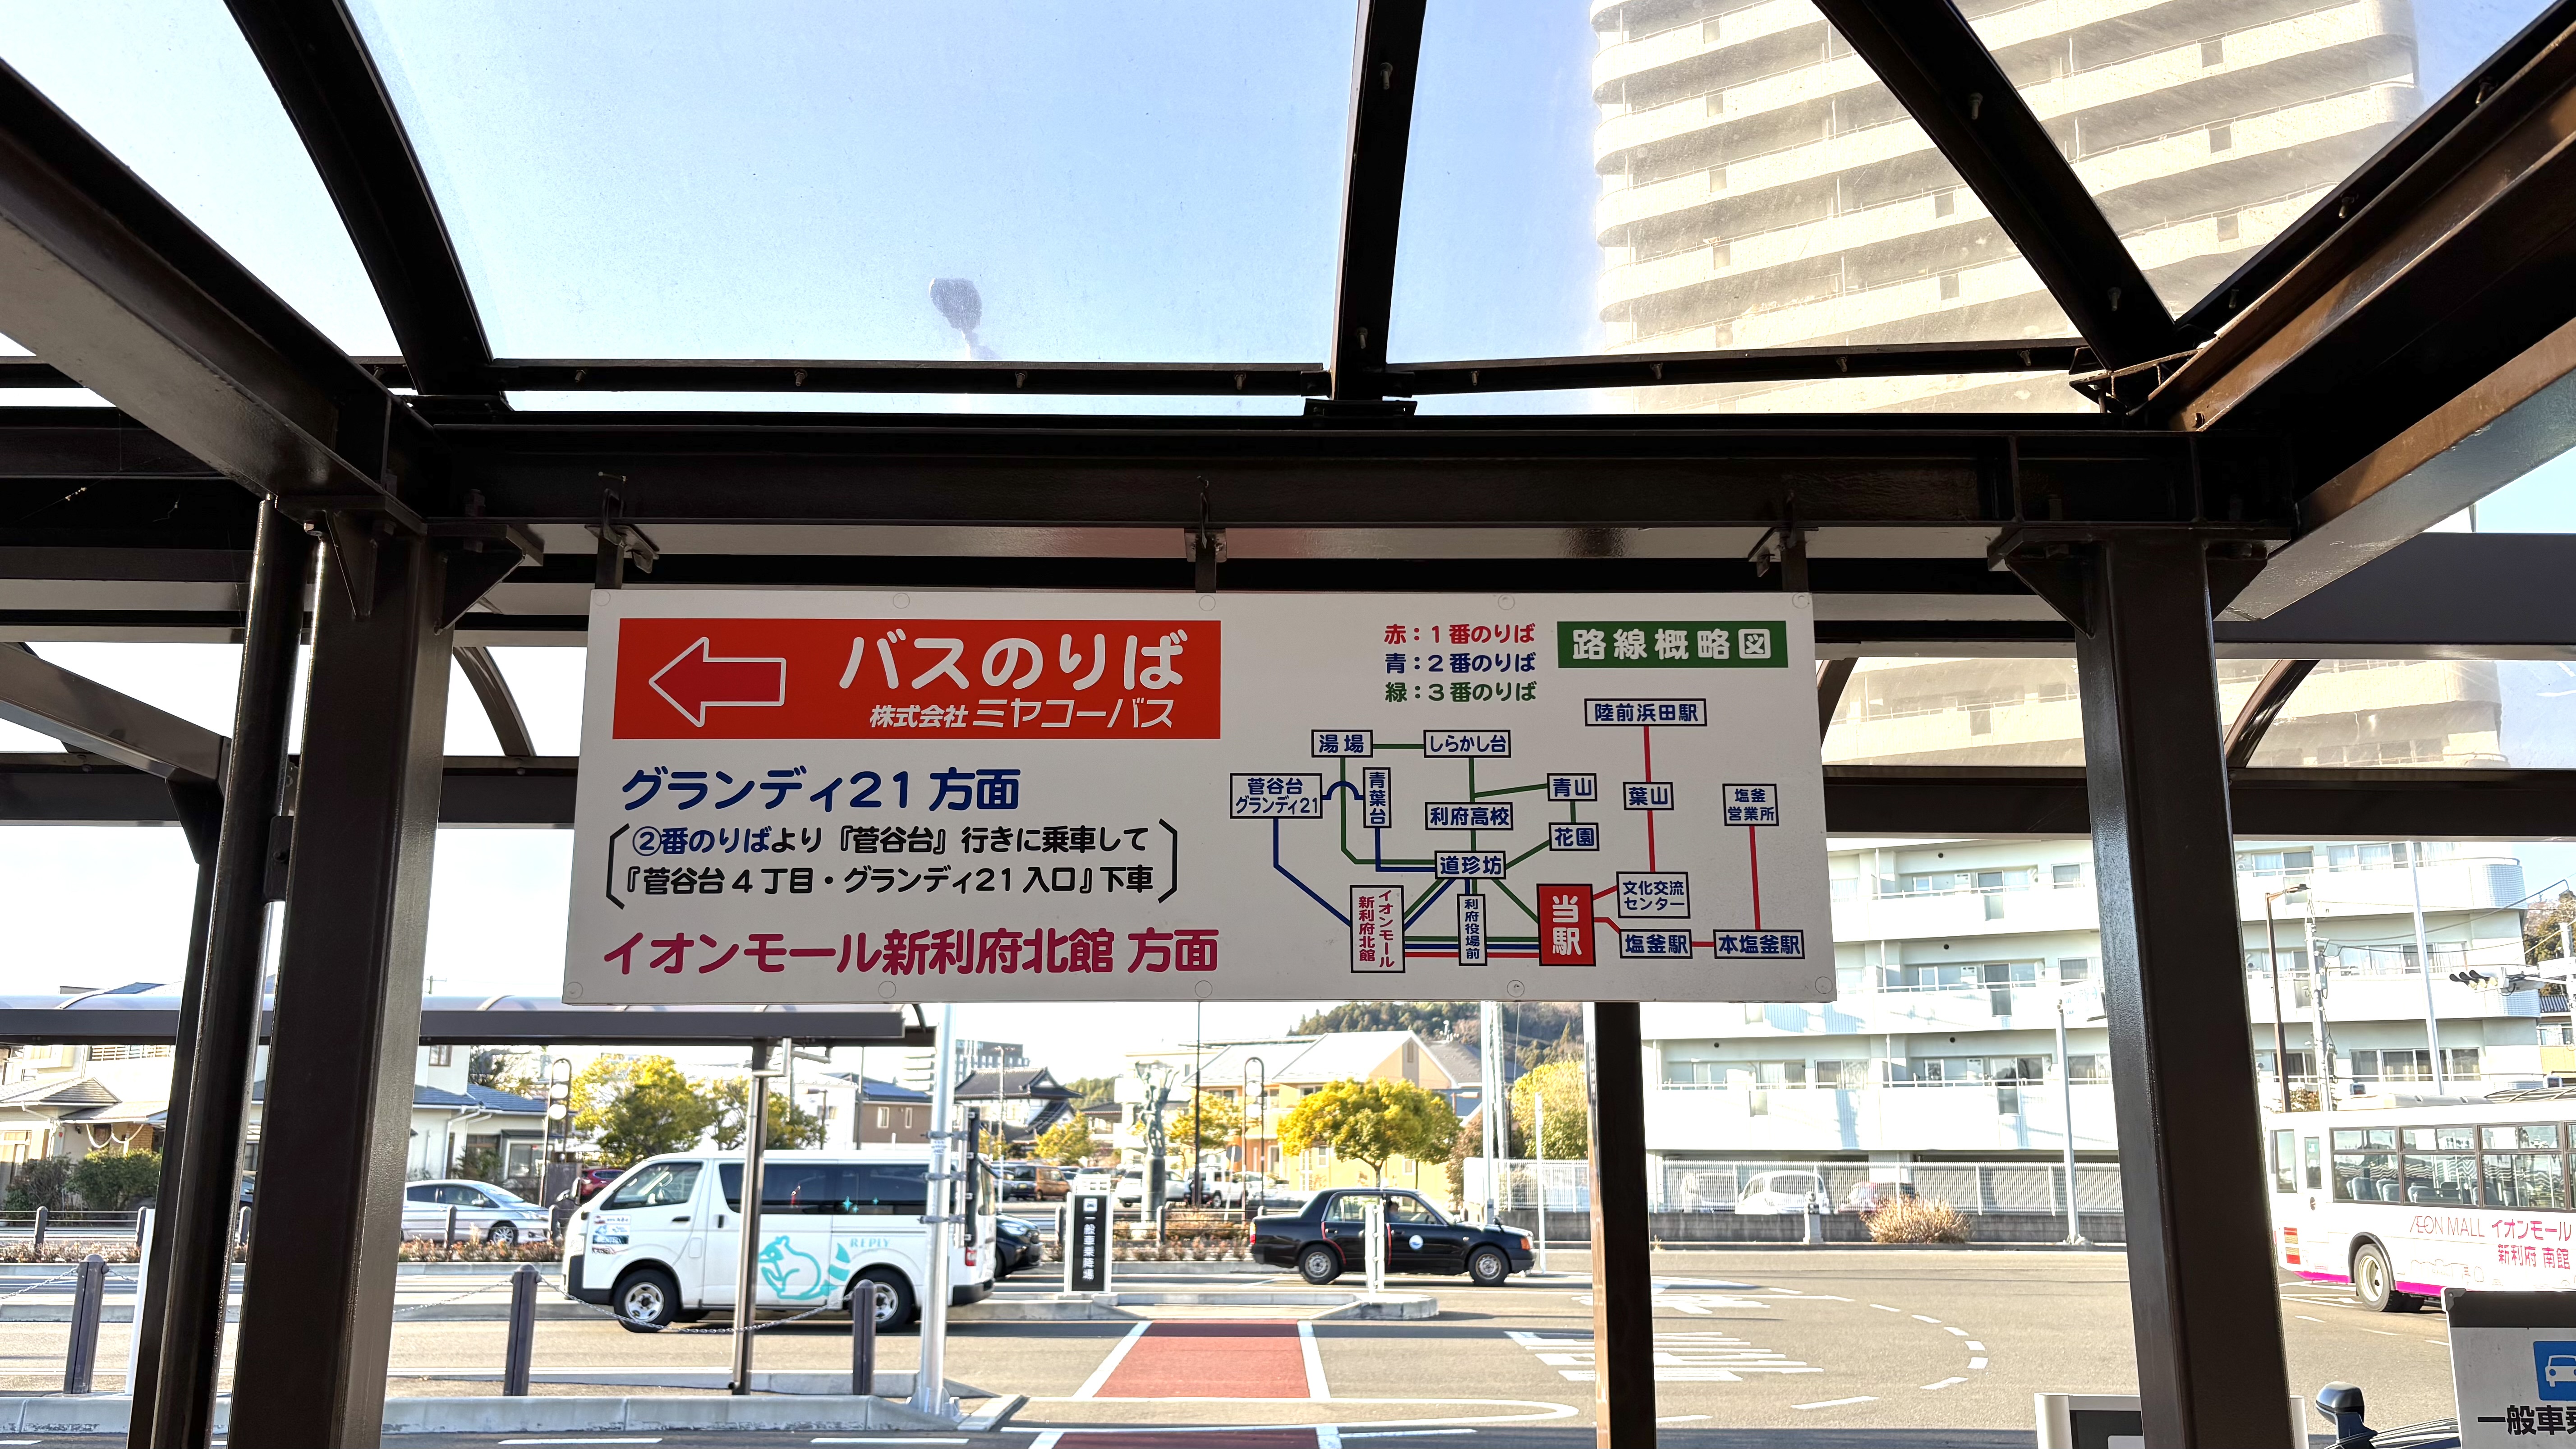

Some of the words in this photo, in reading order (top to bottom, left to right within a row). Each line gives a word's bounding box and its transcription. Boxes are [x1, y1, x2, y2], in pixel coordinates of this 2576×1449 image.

[1573, 628, 1771, 660] 路線概略図
[839, 628, 1188, 691] バスのりば
[1595, 703, 1698, 722] 陸前浜田駅
[1319, 734, 1364, 753] 湯場
[1431, 734, 1506, 753] しらかし台
[1247, 777, 1303, 795] 菅谷台
[1553, 777, 1592, 797] 青山
[1628, 786, 1668, 806] 葉山
[1734, 788, 1766, 803] 塩釜
[1236, 796, 1317, 815] グランディ21
[1369, 771, 1386, 824] 青葉台
[1430, 806, 1509, 826] 利府高校
[1728, 806, 1775, 821] 営業所
[1554, 827, 1595, 846] 花園
[1440, 855, 1502, 875] 道珍坊
[1622, 880, 1684, 896] 文化交流
[1624, 897, 1685, 911] センター
[1358, 896, 1375, 961] 新利府北館
[1378, 890, 1395, 968] イオンモール
[1464, 898, 1480, 959] 利府役場前
[1552, 895, 1582, 955] 当駅
[1625, 934, 1688, 954] 塩釜駅
[1718, 934, 1801, 954] 本塩釜駅
[2447, 1217, 2485, 1237] MALL
[2498, 1244, 2536, 1267] 新利府
